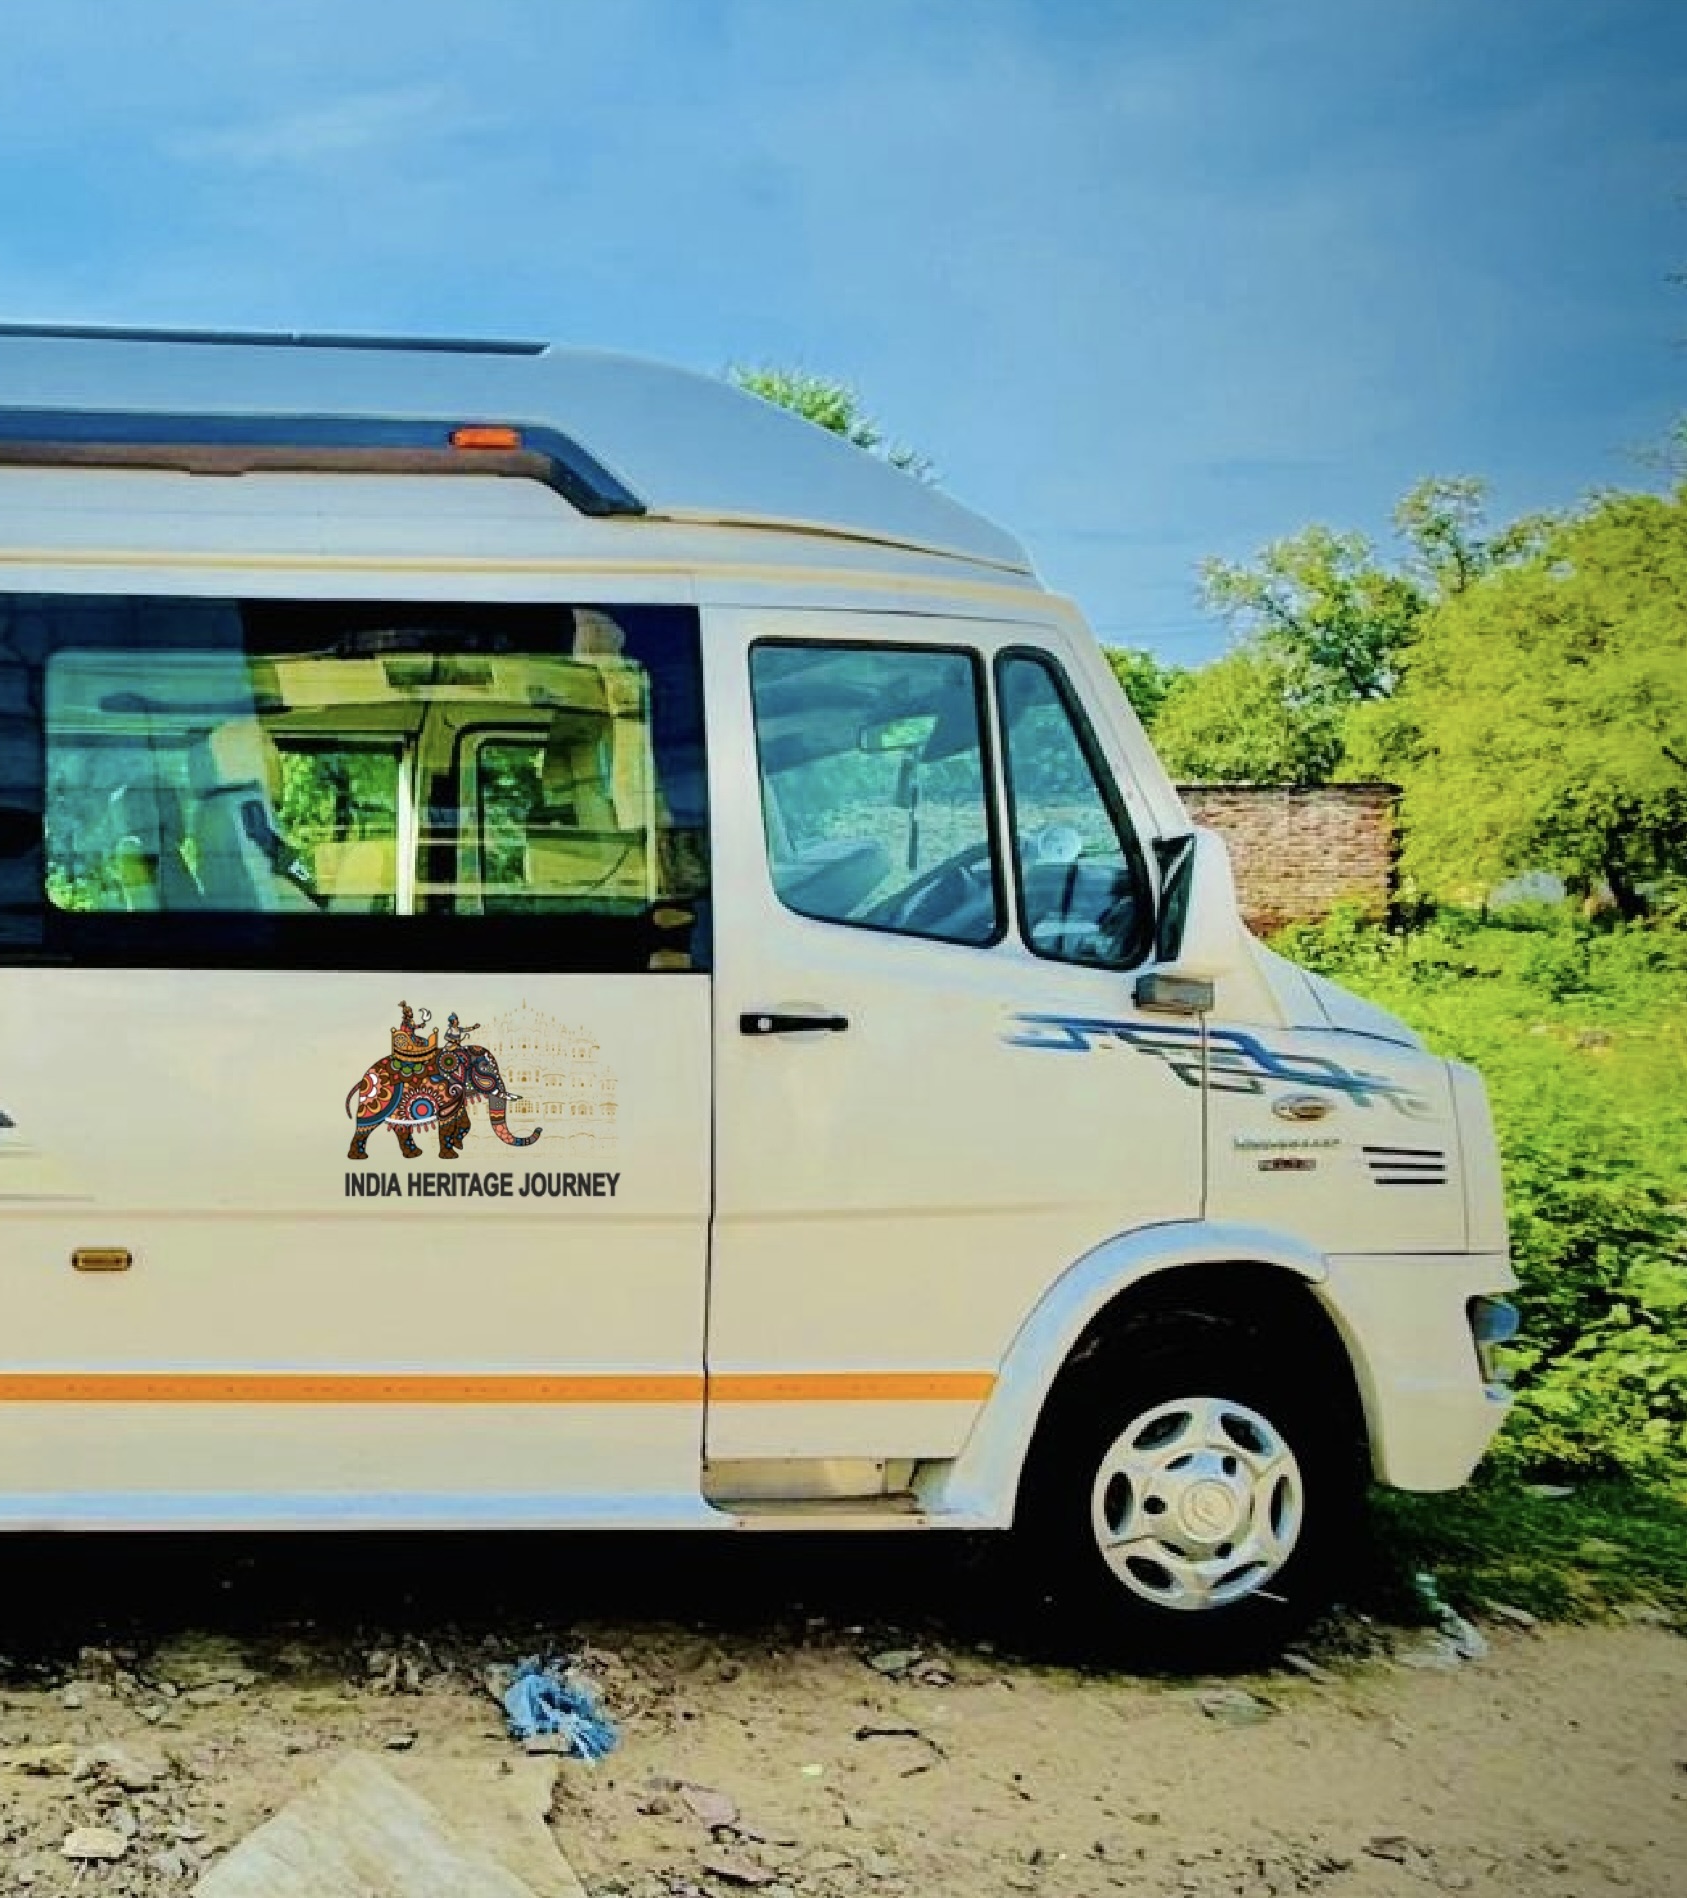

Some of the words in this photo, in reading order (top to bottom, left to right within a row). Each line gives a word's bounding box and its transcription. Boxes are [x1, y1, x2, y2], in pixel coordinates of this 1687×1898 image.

[344, 1171, 402, 1197] INDIA
[407, 1171, 514, 1197] HERITAGE
[518, 1171, 621, 1197] JOURNEY
